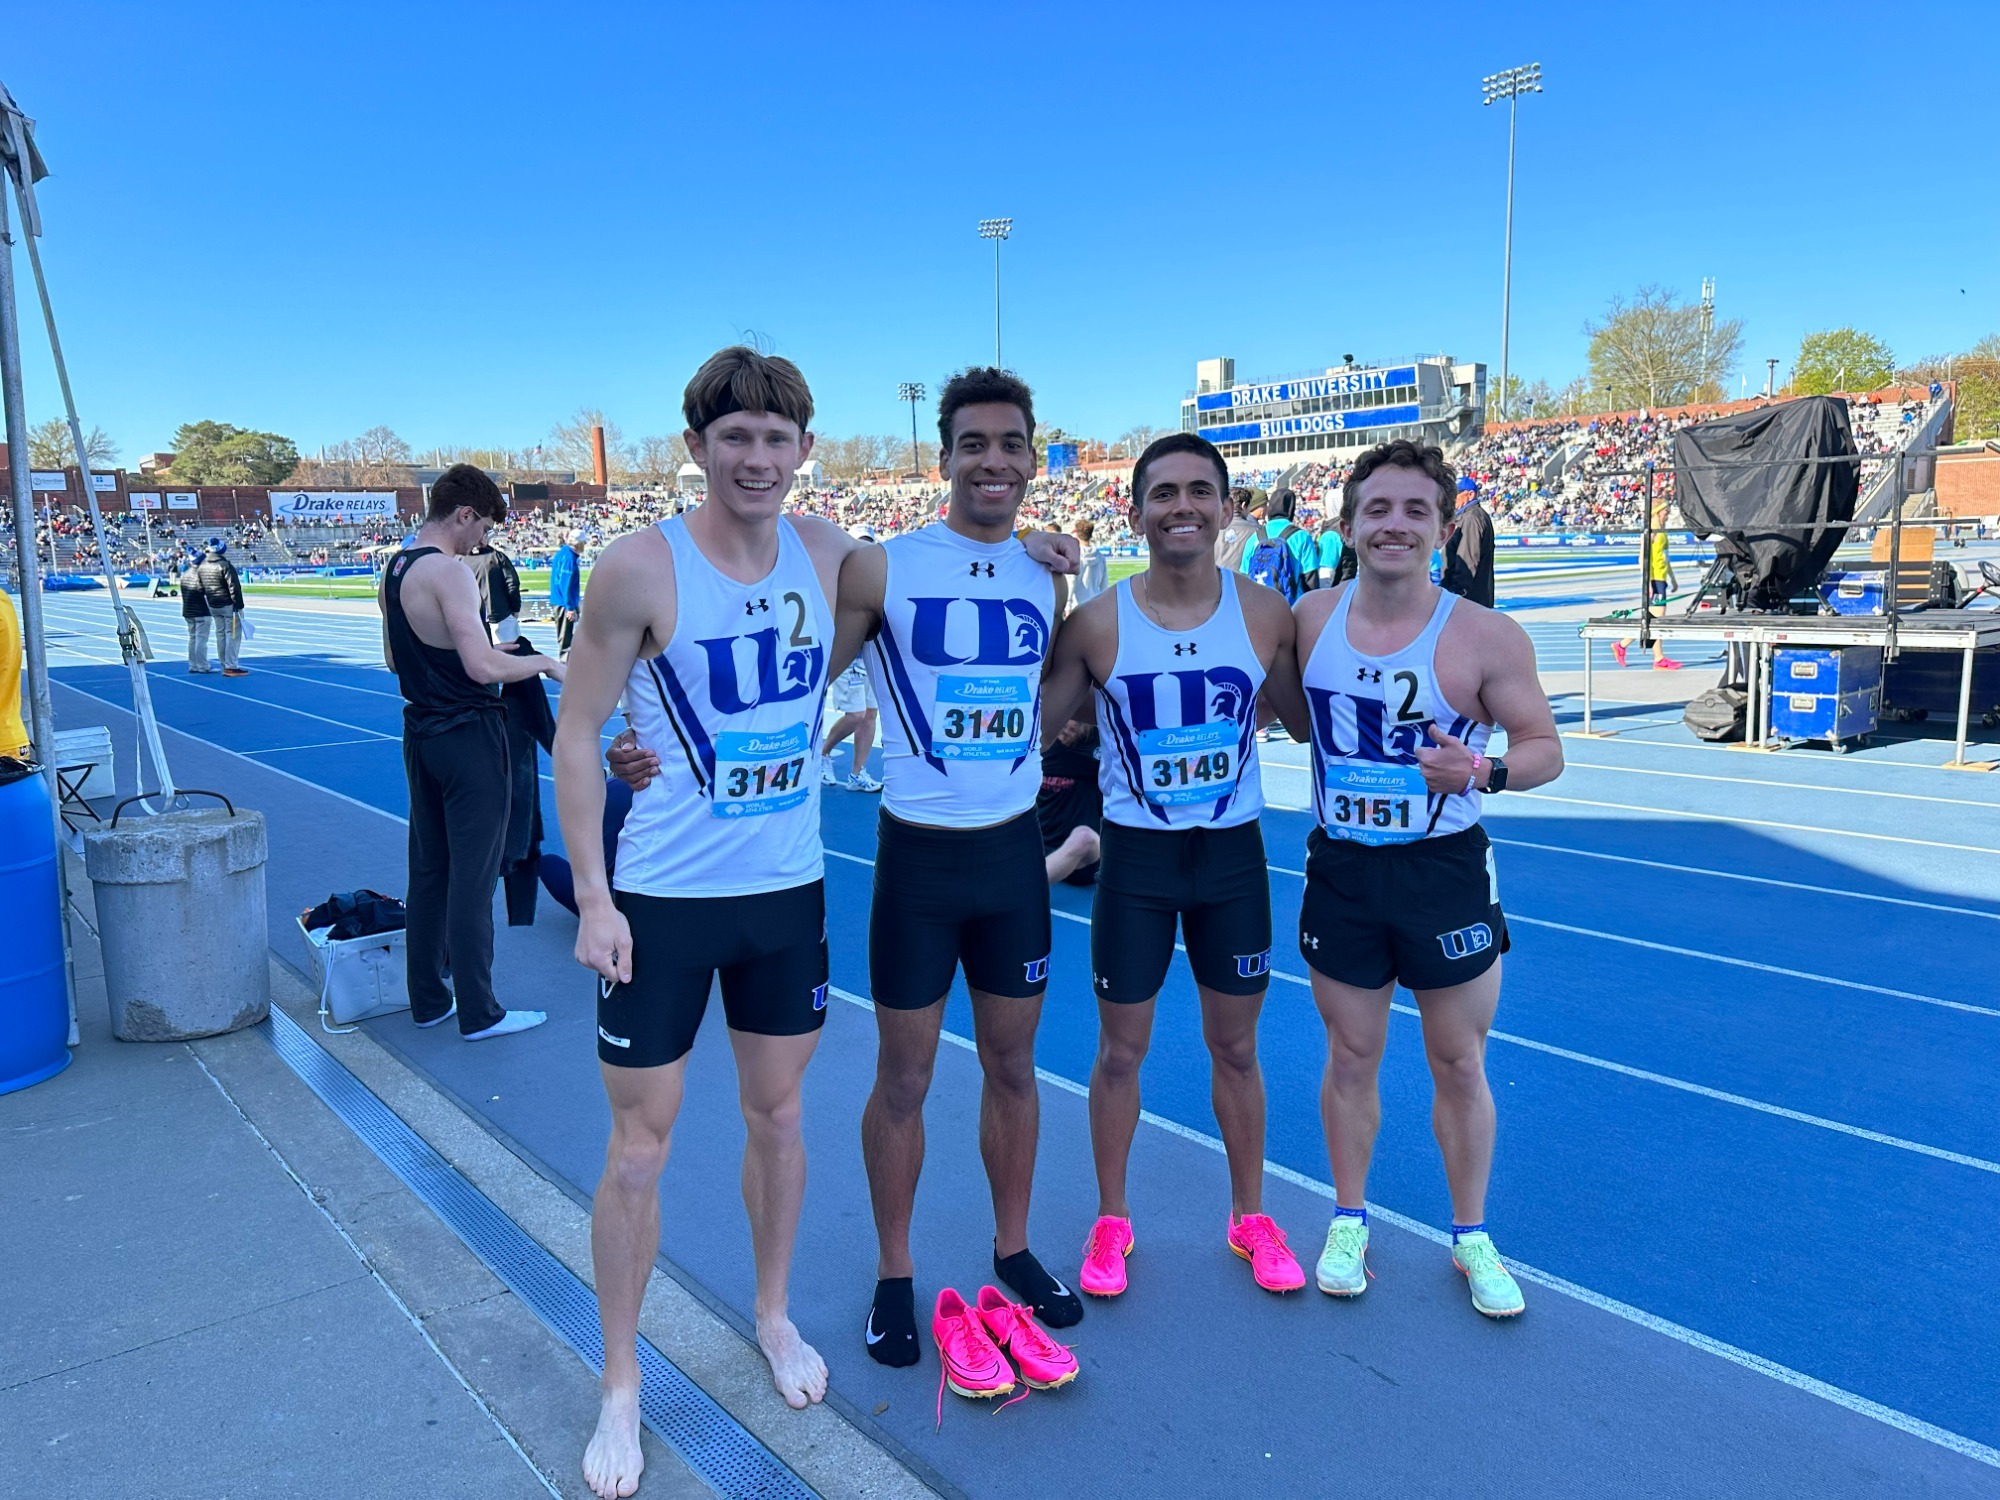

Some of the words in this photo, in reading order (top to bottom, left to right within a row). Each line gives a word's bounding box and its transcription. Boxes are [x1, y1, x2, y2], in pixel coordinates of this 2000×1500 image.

[1231, 386, 1281, 407] DRAKE
[1287, 371, 1388, 399] UNIVERSITY
[1259, 414, 1345, 438] BULLDOGS
[292, 493, 344, 511] Drake
[346, 500, 386, 511] RELAYS
[783, 591, 813, 648] 2
[907, 597, 1049, 667] UD
[963, 682, 995, 694] Drake
[1394, 670, 1424, 722] 2
[945, 708, 1025, 739] 3140
[1166, 733, 1196, 745] Drake
[748, 738, 780, 752] Drake
[728, 757, 805, 797] 3147
[1153, 752, 1230, 788] 3149
[1347, 771, 1378, 784] Drake
[1378, 777, 1405, 785] RELAYS
[1334, 795, 1410, 828] 3151
[1436, 922, 1492, 960] UD
